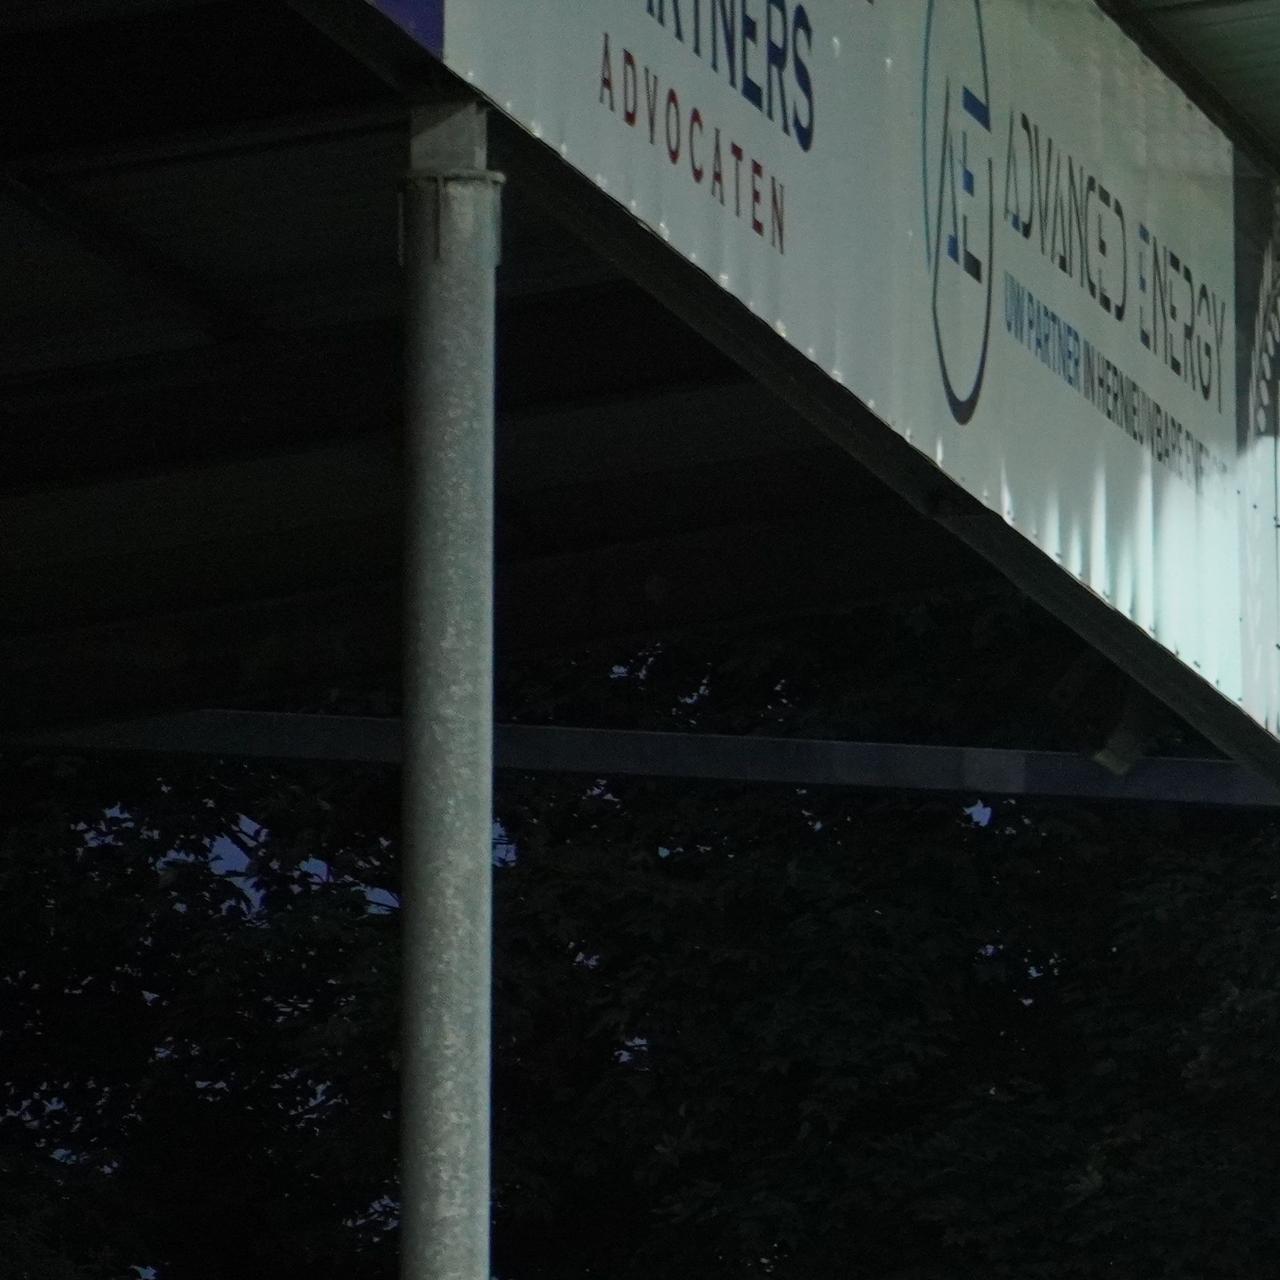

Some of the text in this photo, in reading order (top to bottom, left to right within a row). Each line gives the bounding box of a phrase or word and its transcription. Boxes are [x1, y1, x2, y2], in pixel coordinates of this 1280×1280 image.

[600, 32, 785, 255] ADVOCATEN
[1003, 110, 1226, 415] ADVANCED ENERGY
